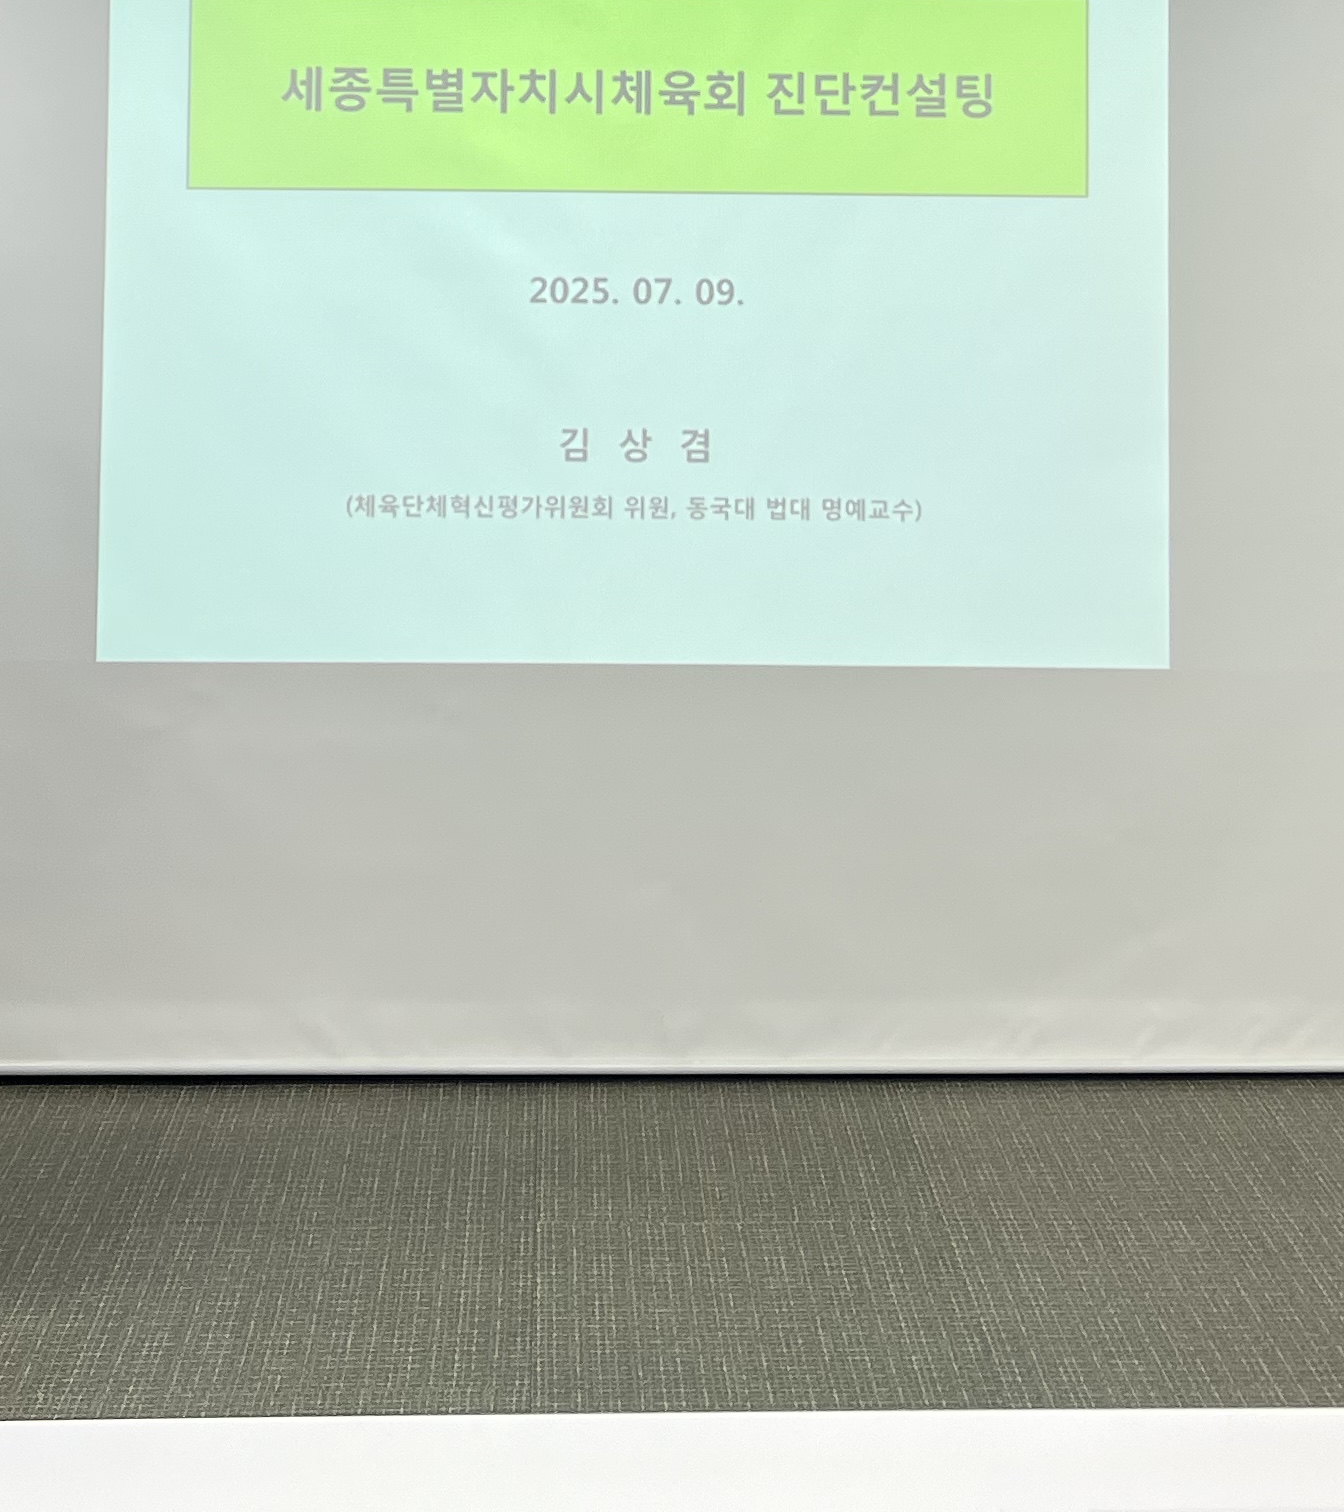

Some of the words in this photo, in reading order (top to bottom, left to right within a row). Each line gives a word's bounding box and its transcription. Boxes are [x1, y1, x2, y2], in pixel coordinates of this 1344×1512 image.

[280, 65, 746, 117] 세종특별자치시체육회
[765, 70, 994, 120] 진단컨설팅
[529, 275, 619, 305] 2025.
[632, 276, 683, 306] 07.
[695, 277, 745, 307] 09.
[345, 494, 614, 521] (체육단체혁신평가위원회
[623, 495, 677, 522] 위원,
[686, 496, 755, 521] 동국대
[766, 496, 812, 522] 법대
[821, 496, 923, 523] 명예교수)
